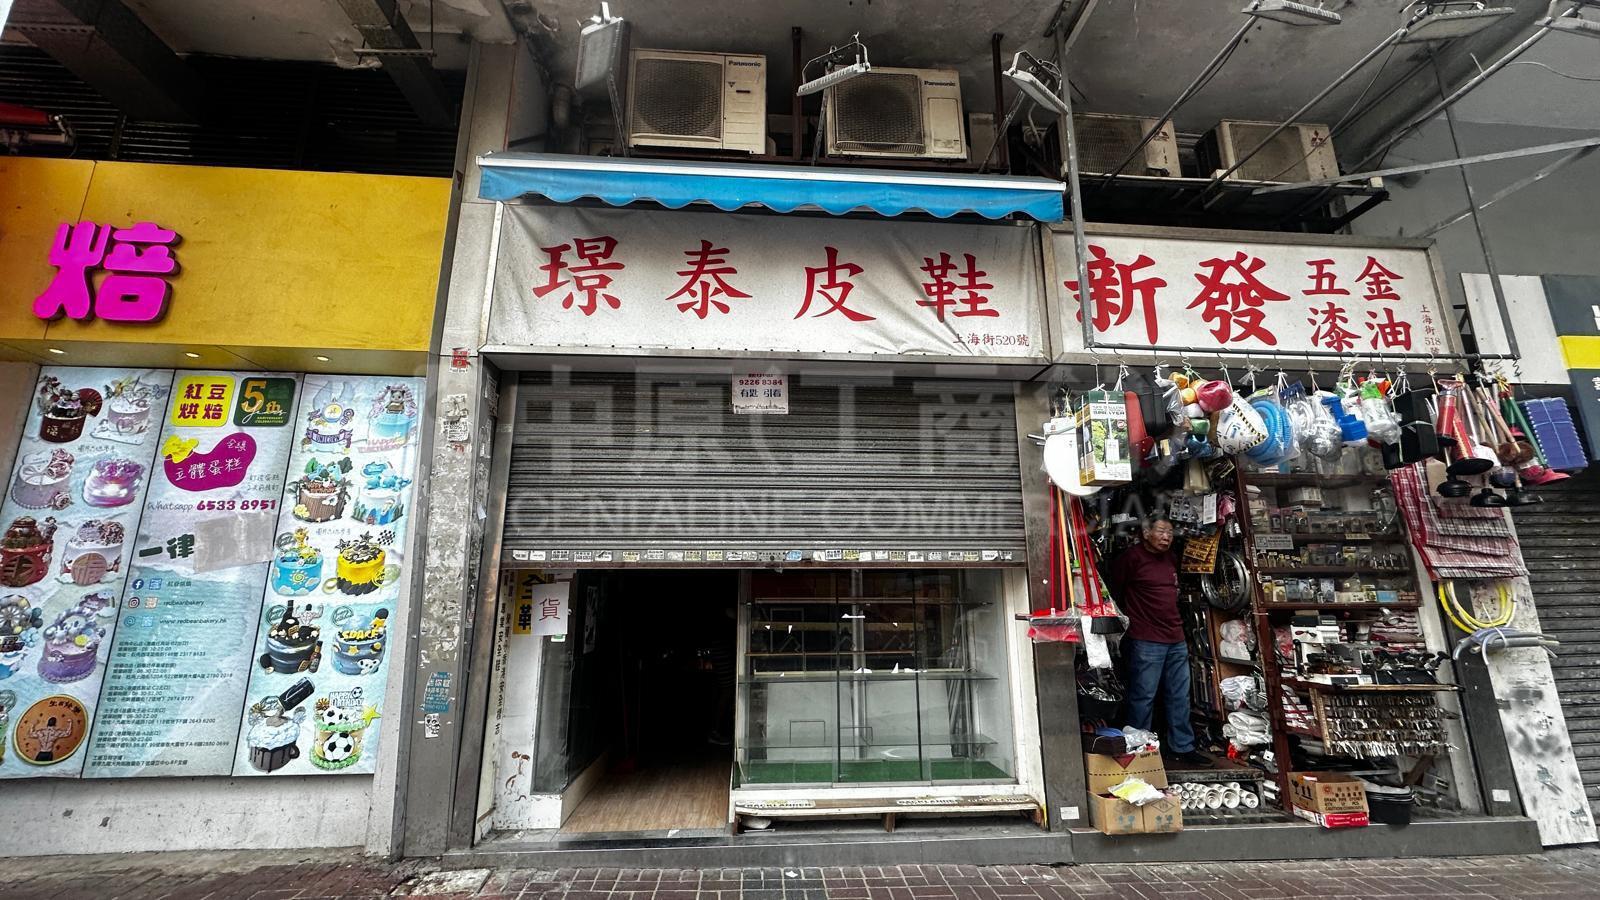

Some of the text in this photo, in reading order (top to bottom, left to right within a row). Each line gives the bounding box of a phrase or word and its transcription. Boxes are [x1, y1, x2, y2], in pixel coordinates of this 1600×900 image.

[33, 221, 182, 323] 焙
[532, 236, 999, 323] 璟泰皮鞋
[1302, 256, 1404, 301] 五金
[1064, 245, 1291, 345] 新發
[953, 332, 1030, 347] 上海街520號
[1307, 302, 1412, 352] 漆油
[184, 384, 227, 400] 紅豆
[178, 403, 223, 420] 烘焙
[147, 500, 276, 513] Whatsapp 6533 8951
[539, 598, 561, 621] 貨
